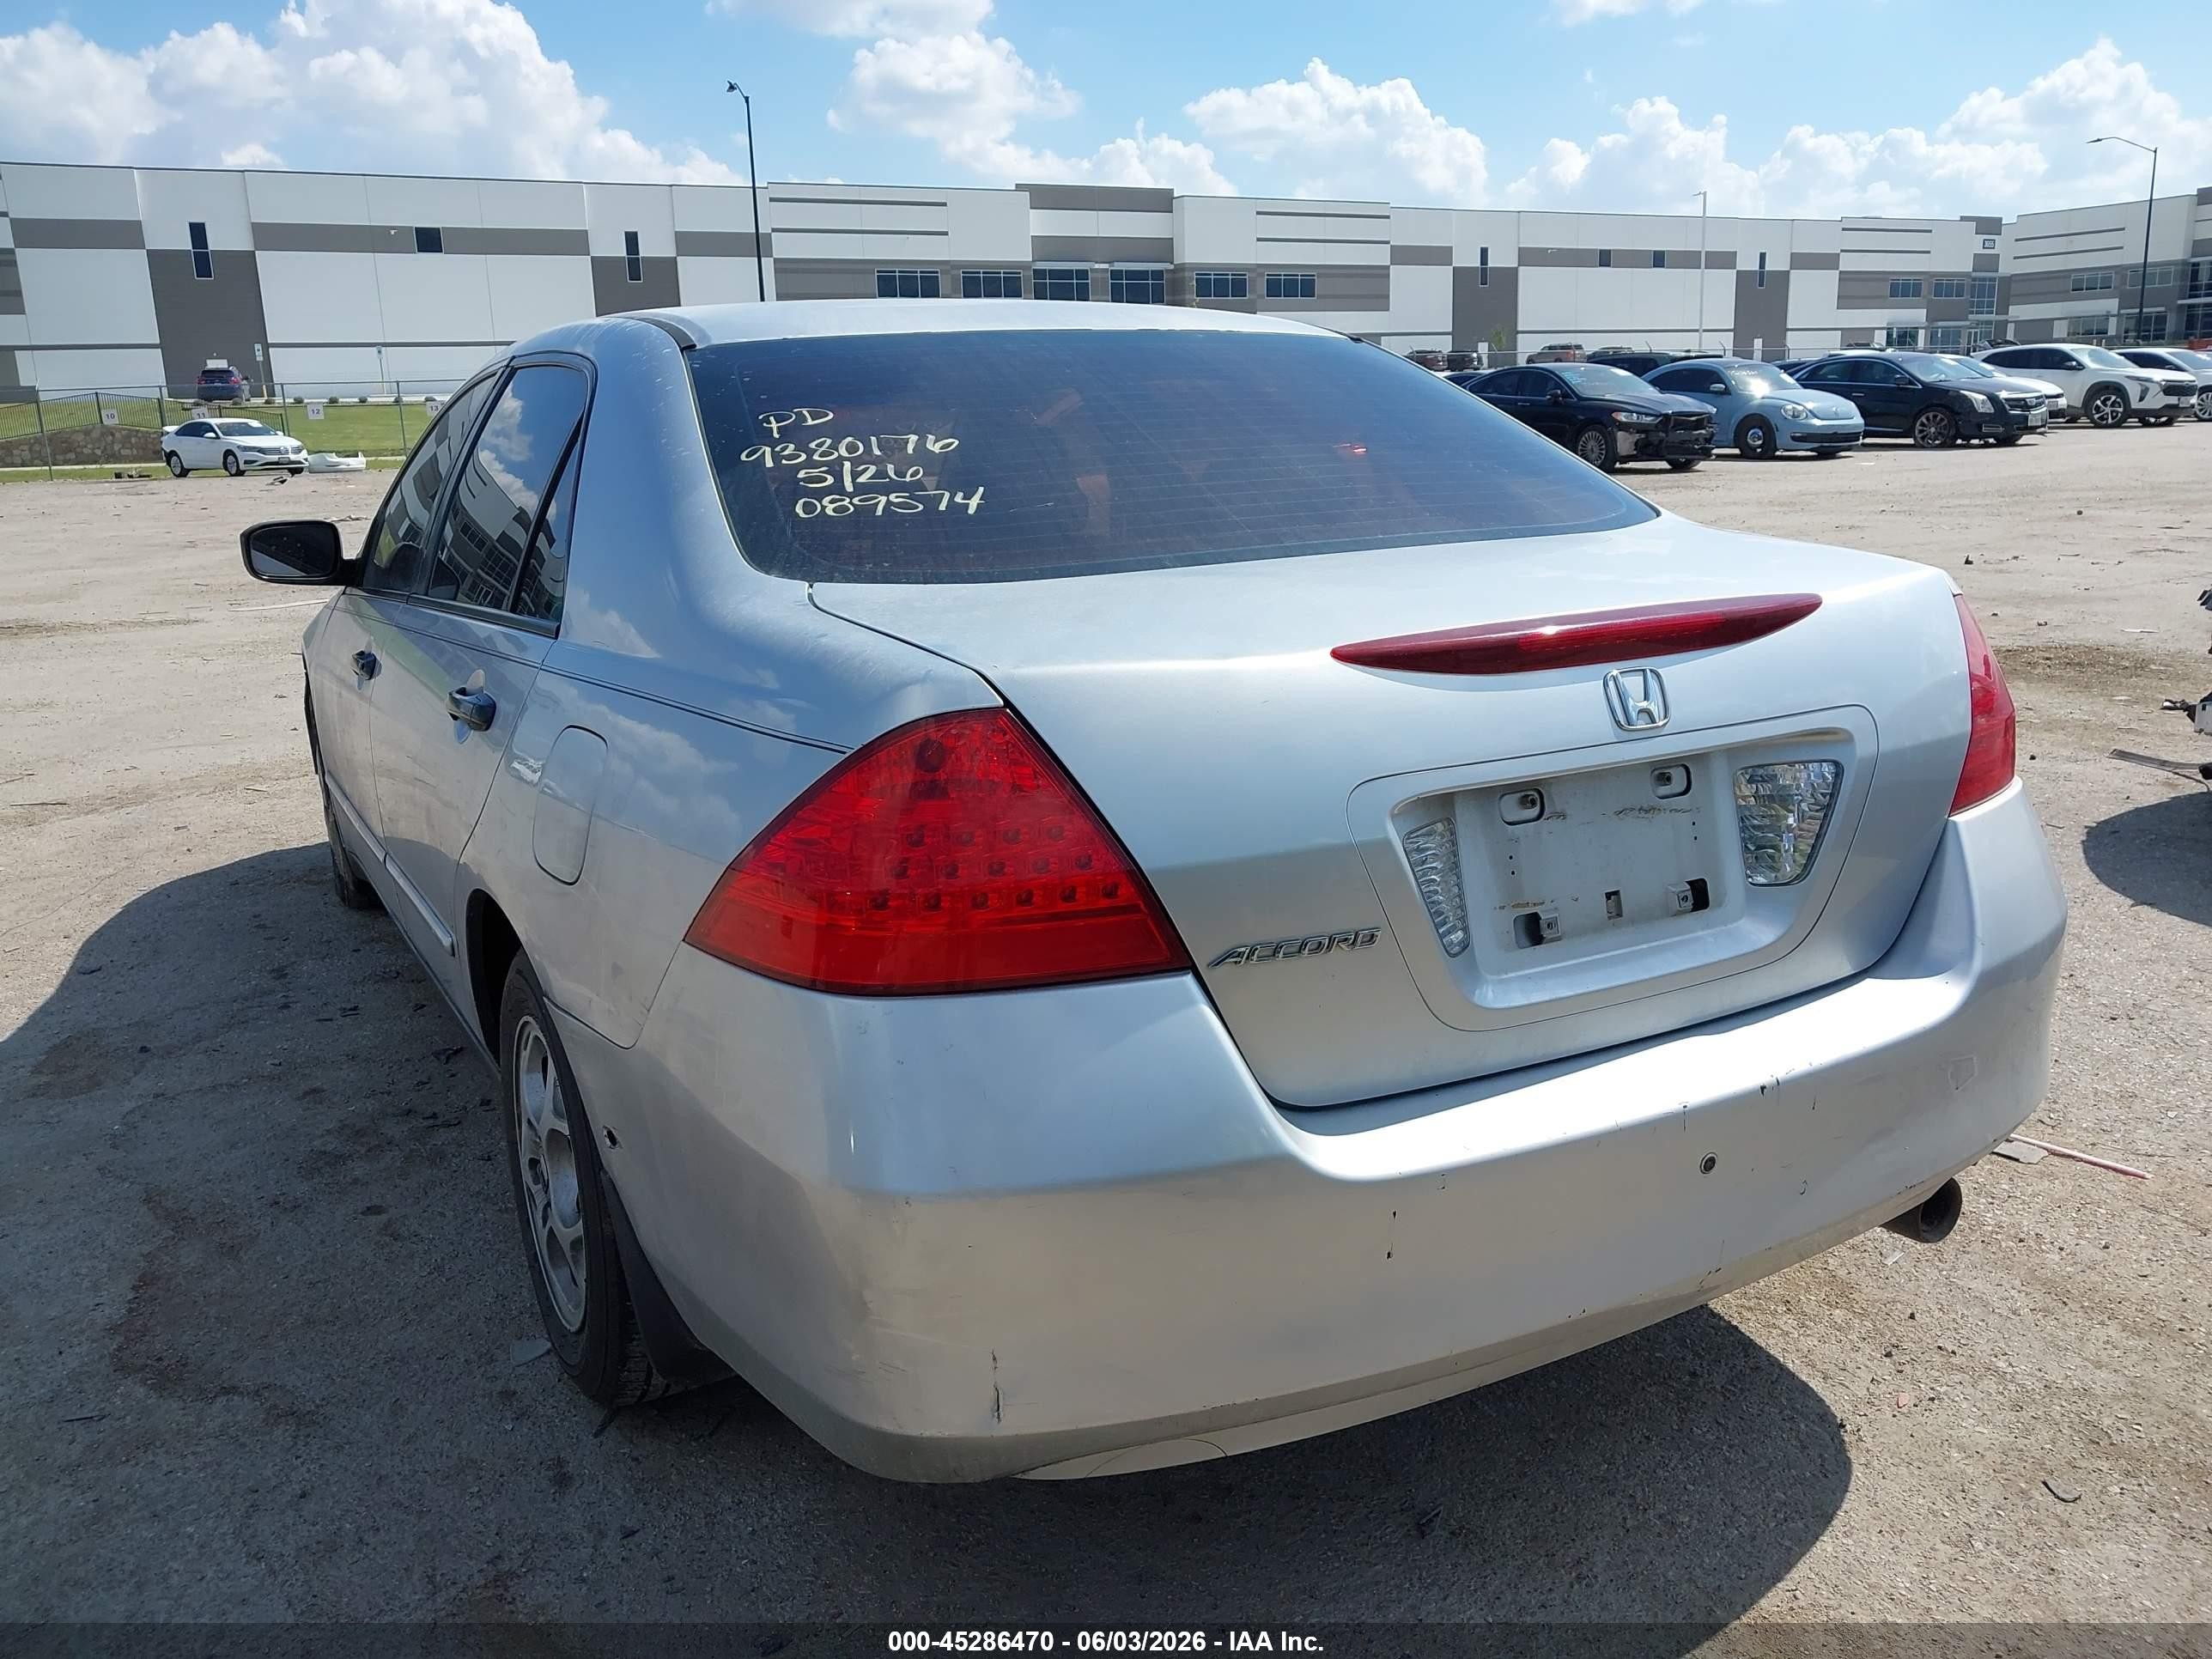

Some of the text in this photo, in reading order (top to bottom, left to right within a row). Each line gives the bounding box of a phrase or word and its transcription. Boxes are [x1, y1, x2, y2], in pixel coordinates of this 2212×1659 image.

[758, 408, 834, 438] PD
[740, 434, 960, 467] 9380176
[794, 487, 986, 518] 089574
[1207, 927, 1382, 969] ACCORD
